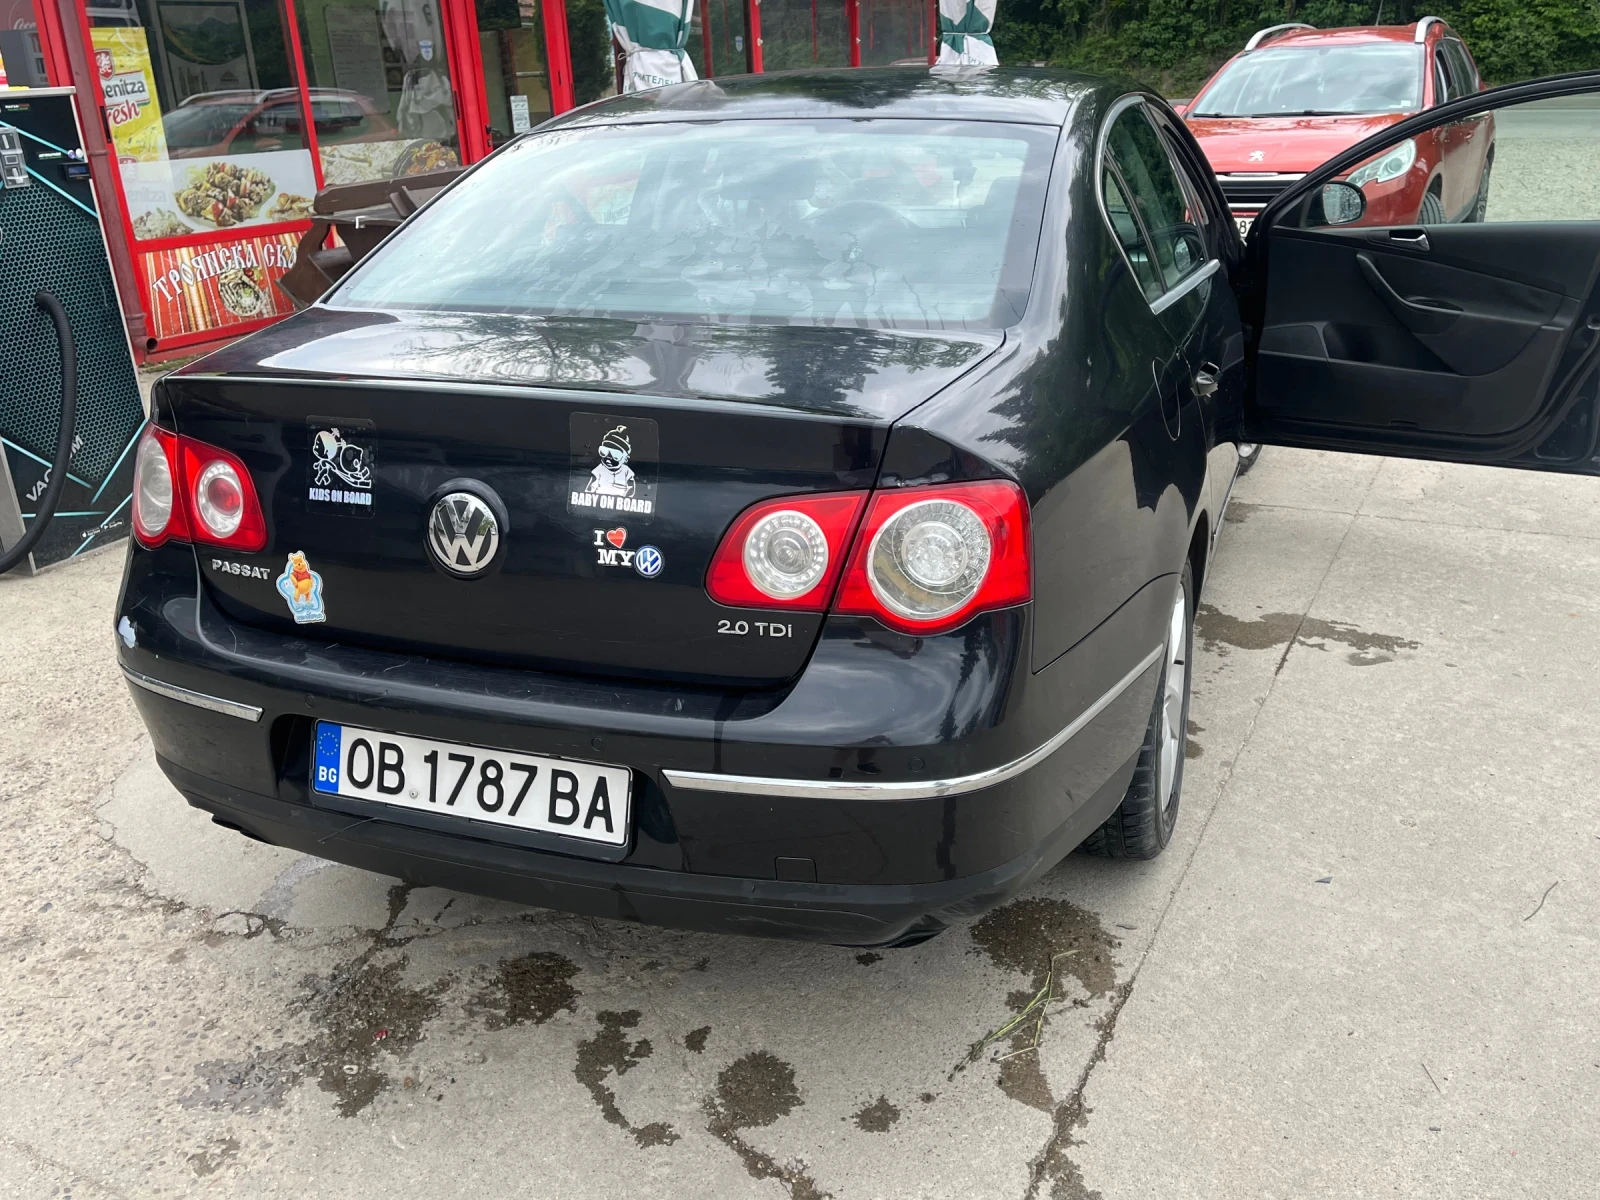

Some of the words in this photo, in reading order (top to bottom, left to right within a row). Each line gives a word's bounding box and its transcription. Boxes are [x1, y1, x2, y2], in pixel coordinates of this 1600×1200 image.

[103, 79, 146, 98] enitza
[106, 99, 140, 125] resh
[263, 243, 297, 269] СКА
[309, 487, 331, 502] KIDS
[331, 489, 343, 503] ON
[343, 490, 372, 506] BOARD
[571, 491, 599, 507] BABY
[600, 495, 615, 510] ON
[615, 497, 652, 514] BOARD
[593, 529, 605, 546] I
[597, 548, 636, 567] MY
[211, 558, 271, 580] PASSAT
[754, 621, 793, 638] TDI
[318, 765, 338, 784] BG
[346, 737, 406, 796] OB
[423, 749, 539, 818] 1787
[547, 768, 614, 834] BA
